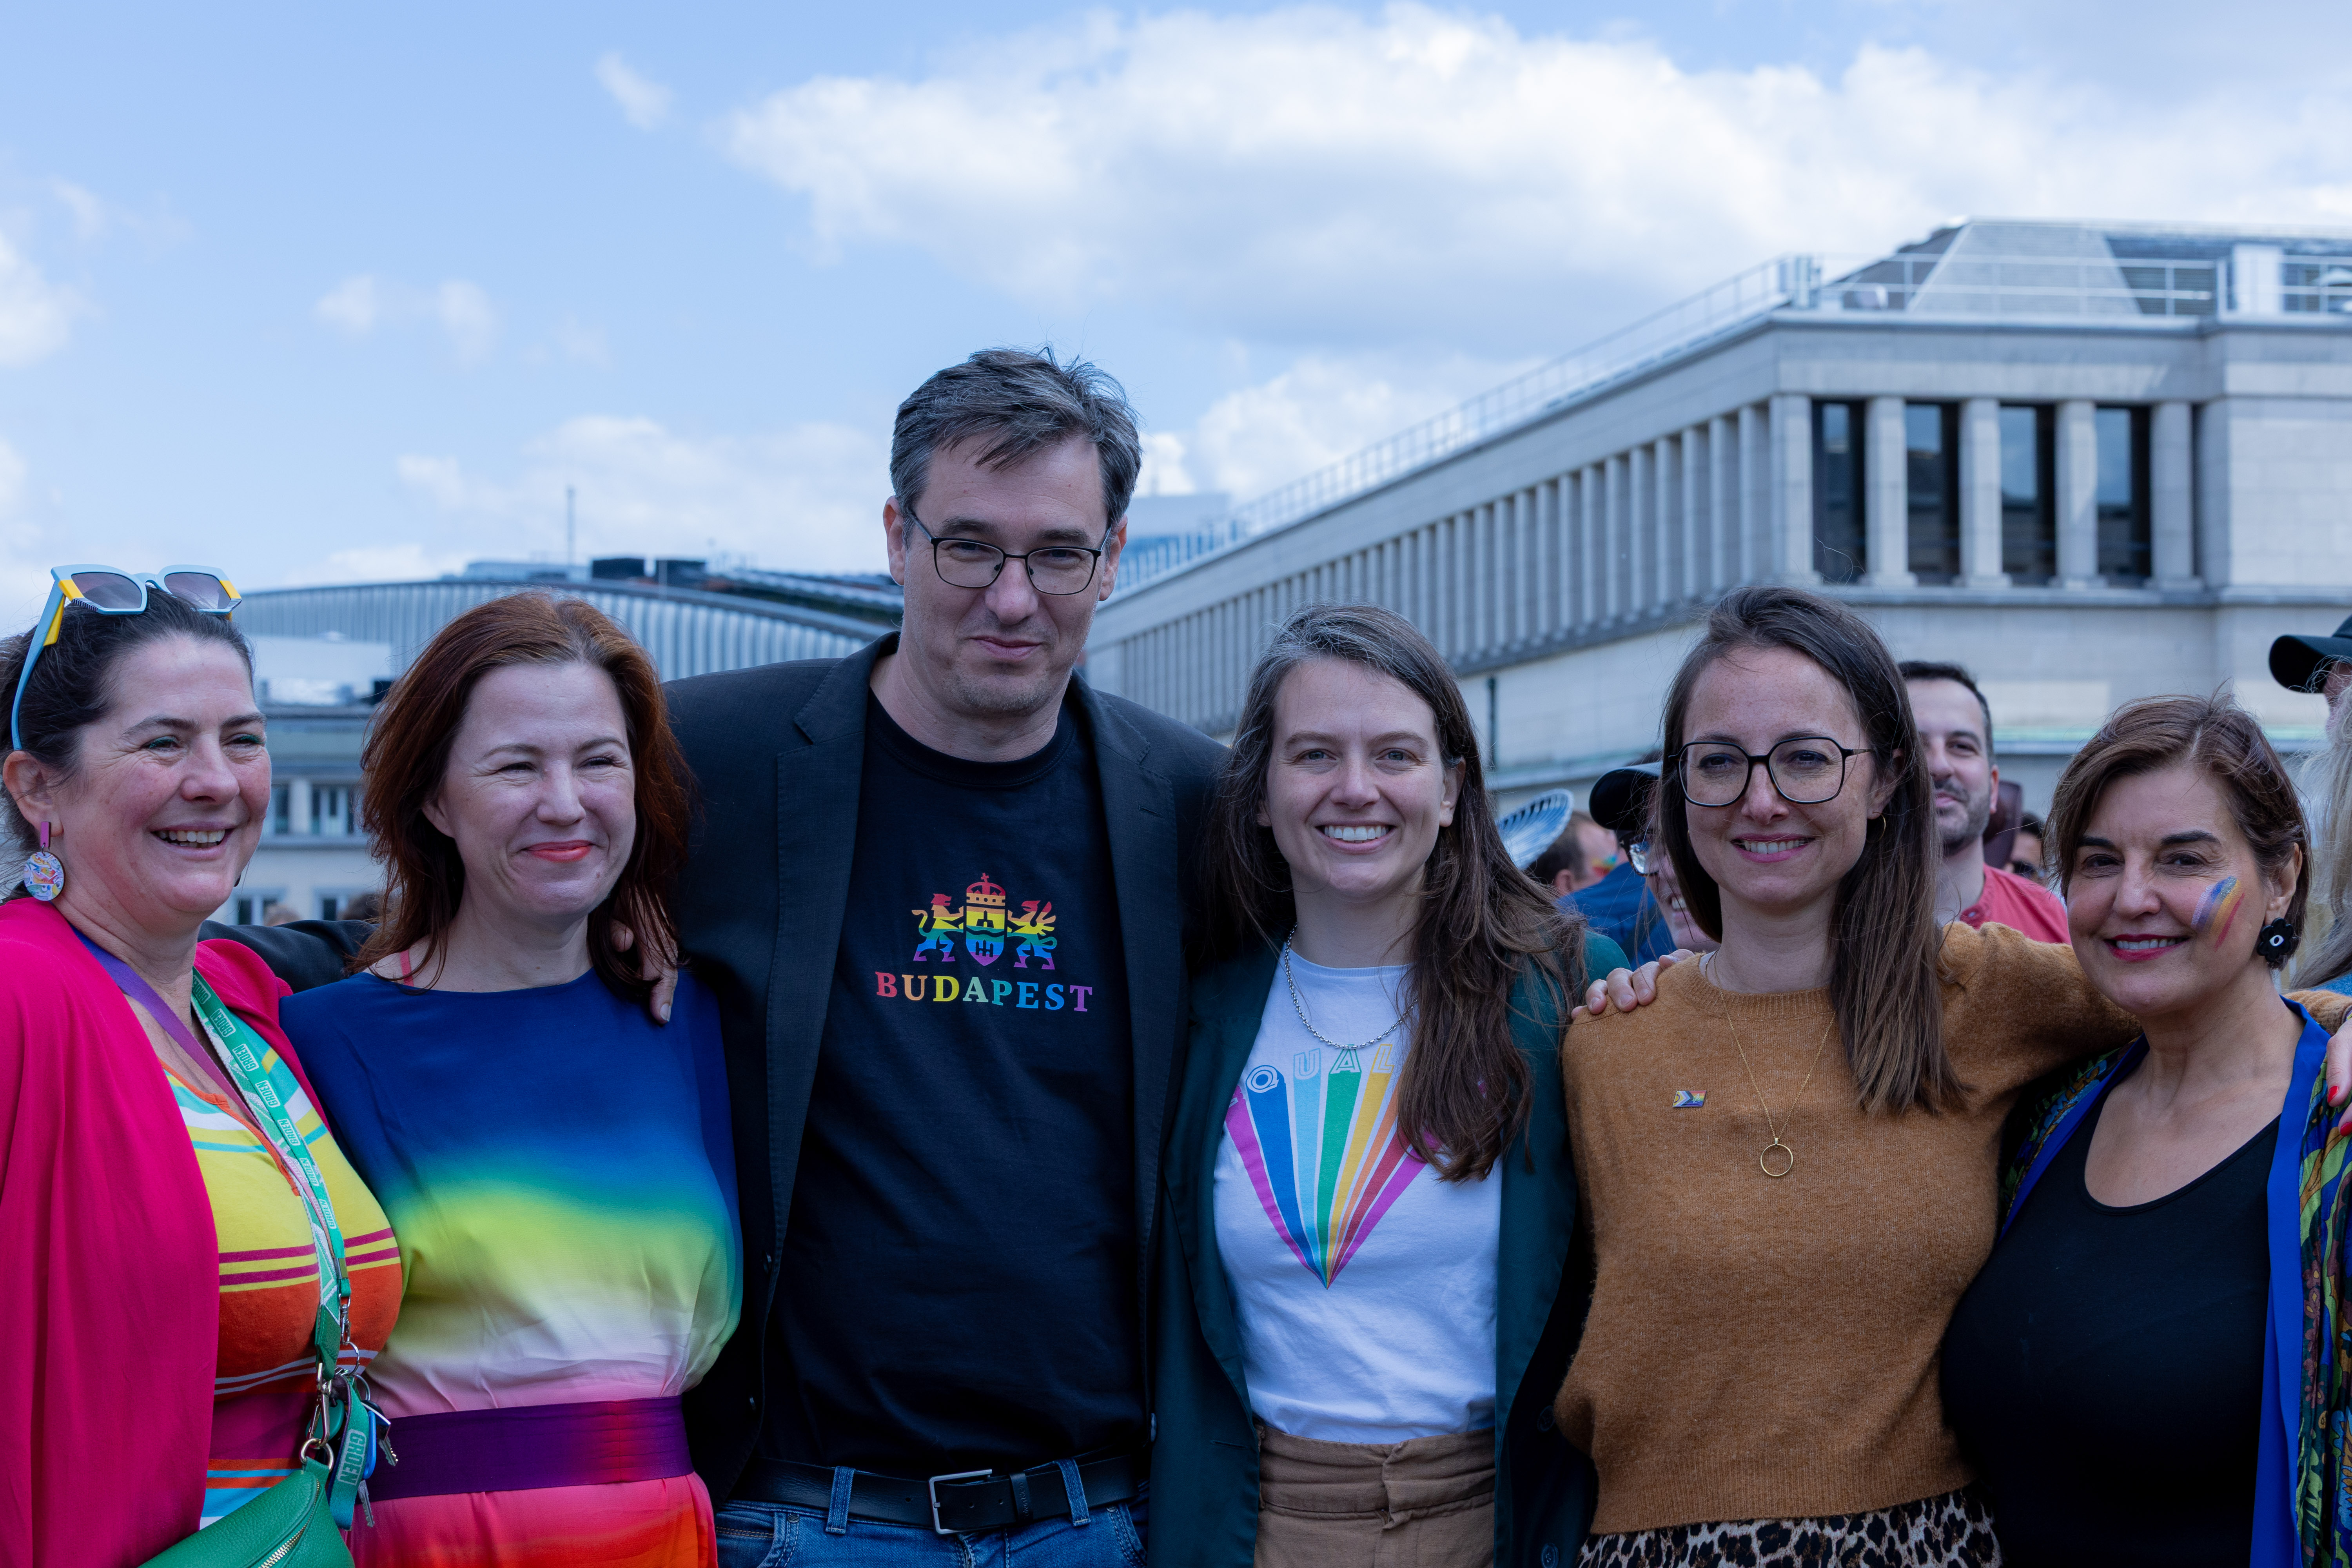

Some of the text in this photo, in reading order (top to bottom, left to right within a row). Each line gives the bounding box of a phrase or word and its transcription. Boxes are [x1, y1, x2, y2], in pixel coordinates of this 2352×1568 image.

[875, 971, 1093, 1012] BUDAPEST
[211, 1009, 234, 1036] GROEN
[233, 1044, 257, 1071] GROEN
[256, 1081, 279, 1107] GROEN
[279, 1119, 299, 1145] GROEN
[300, 1158, 318, 1185] GROEN
[319, 1200, 336, 1228] GROEN
[340, 1433, 365, 1484] GROEN
